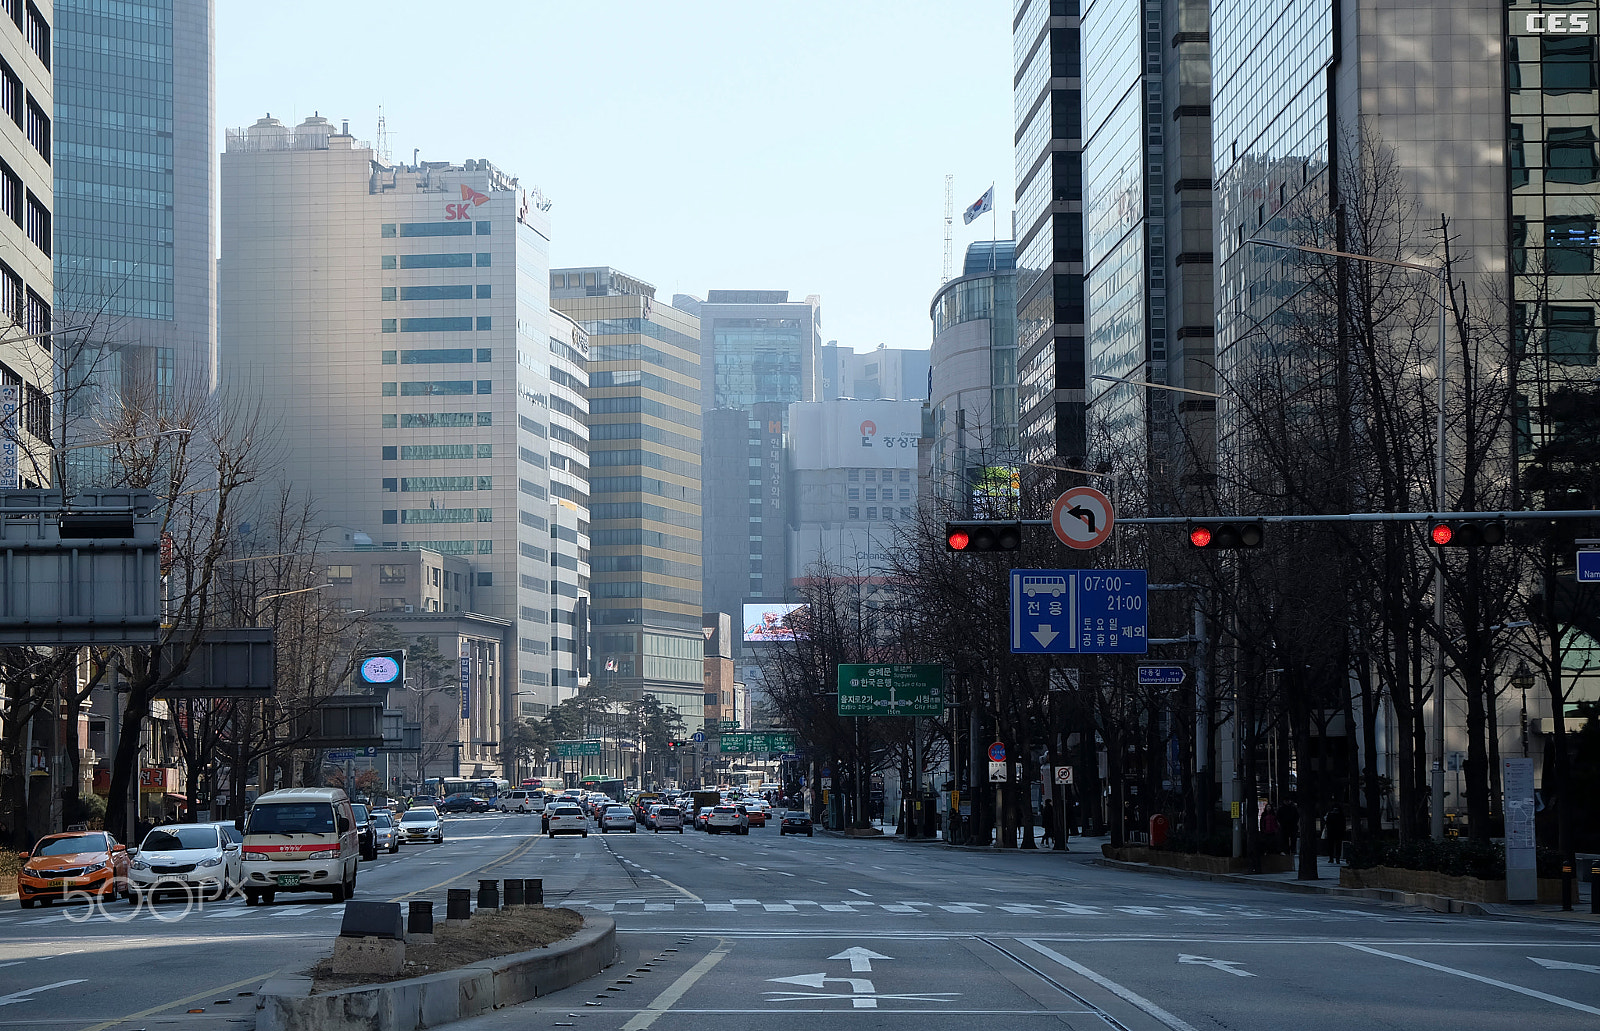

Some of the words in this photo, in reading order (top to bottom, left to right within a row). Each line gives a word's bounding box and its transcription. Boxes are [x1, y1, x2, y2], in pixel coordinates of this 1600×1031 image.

[445, 204, 470, 220] SK
[1107, 595, 1142, 610] 21:00
[1121, 625, 1145, 638] 제외
[868, 667, 892, 677] 숭례문
[1140, 669, 1161, 677] 다동길
[860, 679, 892, 688] 한국은행
[841, 695, 873, 704] 을지로2가
[914, 695, 930, 704] 시청
